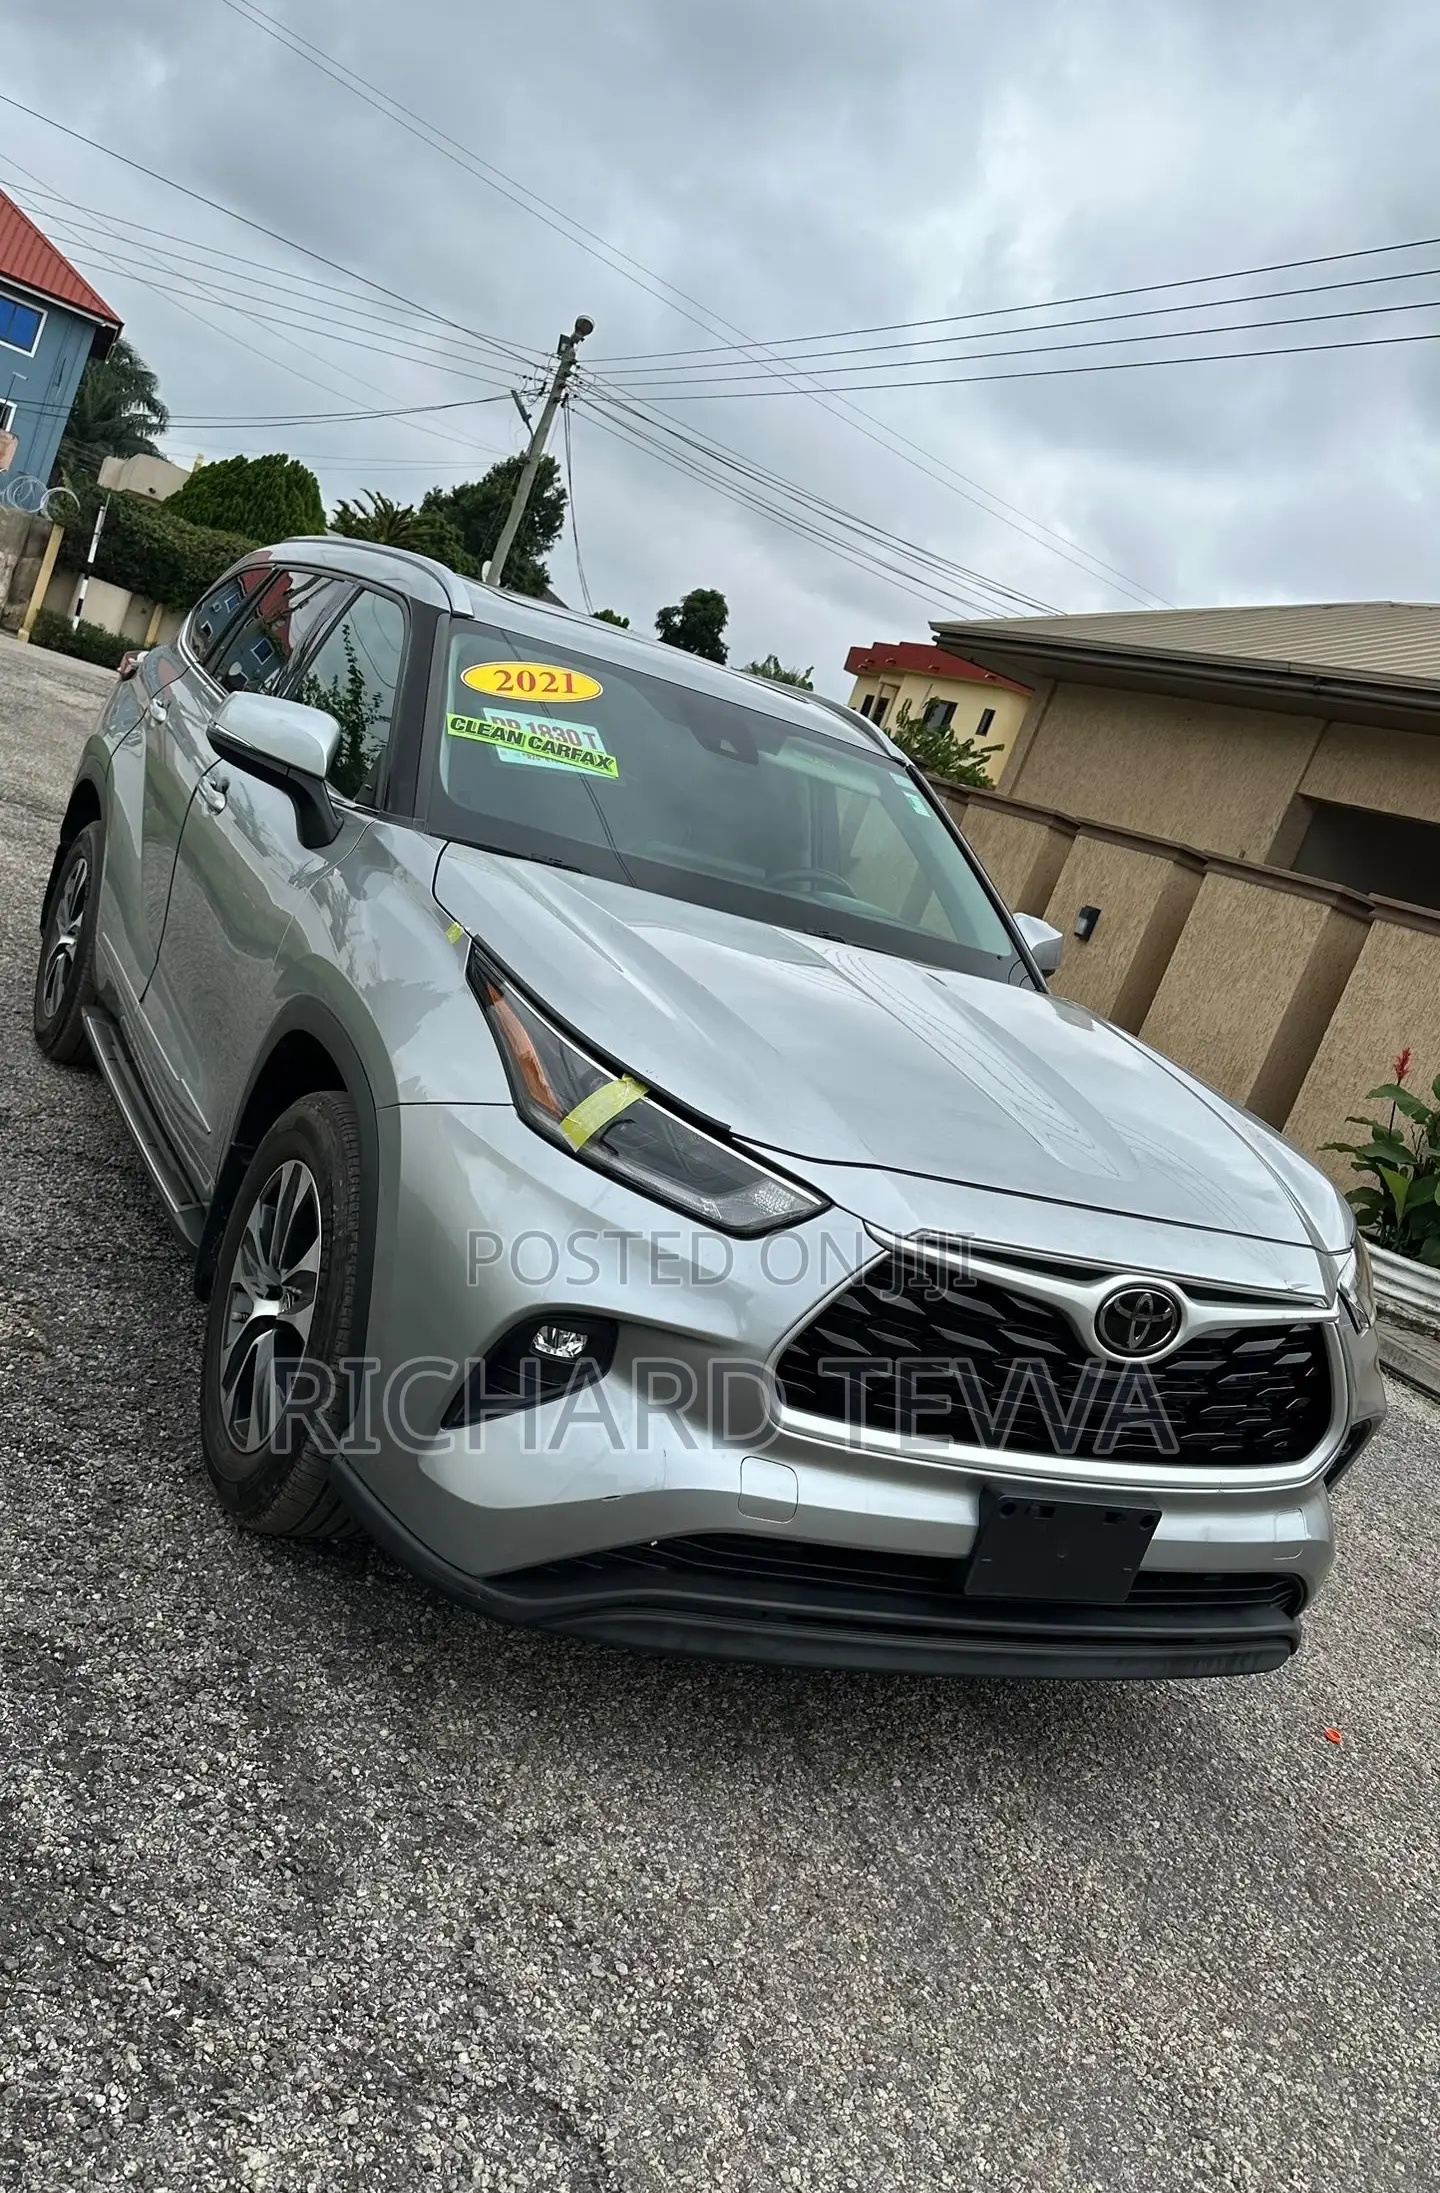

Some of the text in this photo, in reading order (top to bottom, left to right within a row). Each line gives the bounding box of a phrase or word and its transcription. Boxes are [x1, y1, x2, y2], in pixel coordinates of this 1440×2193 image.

[493, 670, 577, 693] 2021
[450, 717, 612, 770] CLEAN CARFAX
[526, 721, 583, 746] 1830
[582, 731, 596, 749] T
